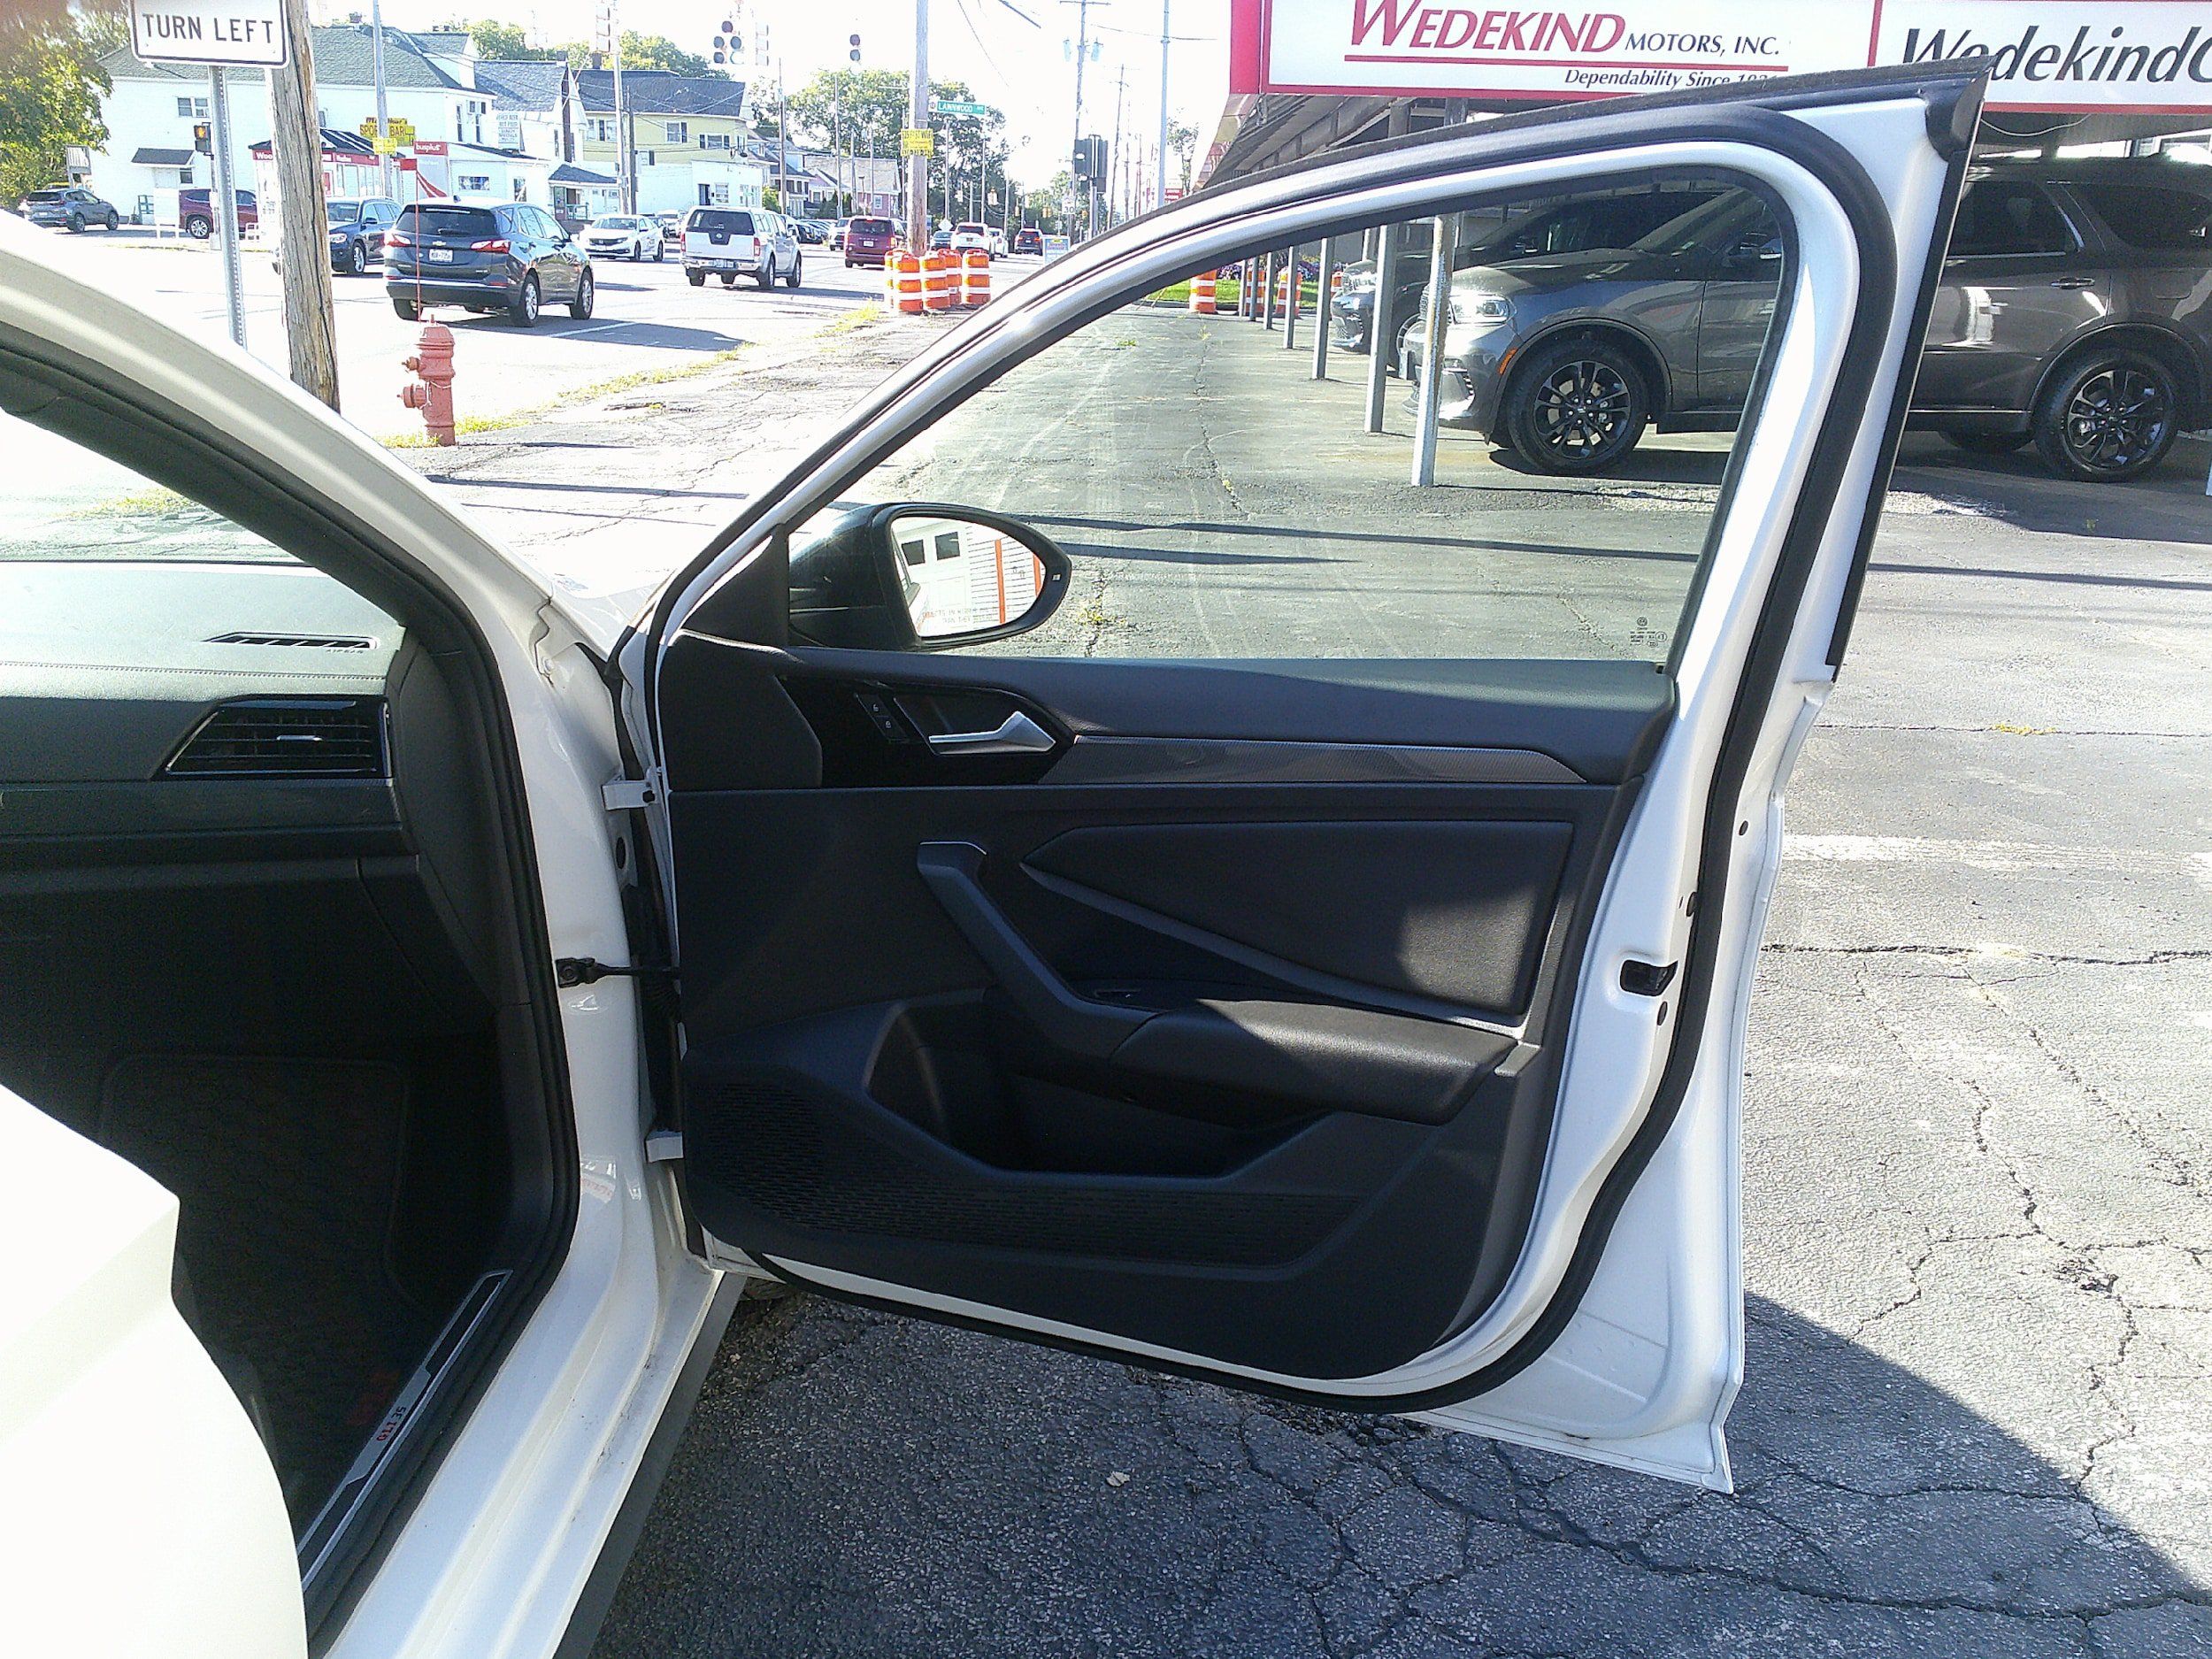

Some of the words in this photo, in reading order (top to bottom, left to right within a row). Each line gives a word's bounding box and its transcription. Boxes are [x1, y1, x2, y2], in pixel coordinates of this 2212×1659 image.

[142, 13, 202, 41] TURN
[213, 17, 273, 44] LEFT
[1350, 0, 1626, 53] WEDEKIND
[1624, 32, 1725, 58] MOTORS,
[1733, 35, 1780, 56] INC.
[1563, 68, 1684, 90] Dependability
[1686, 71, 1731, 89] Since
